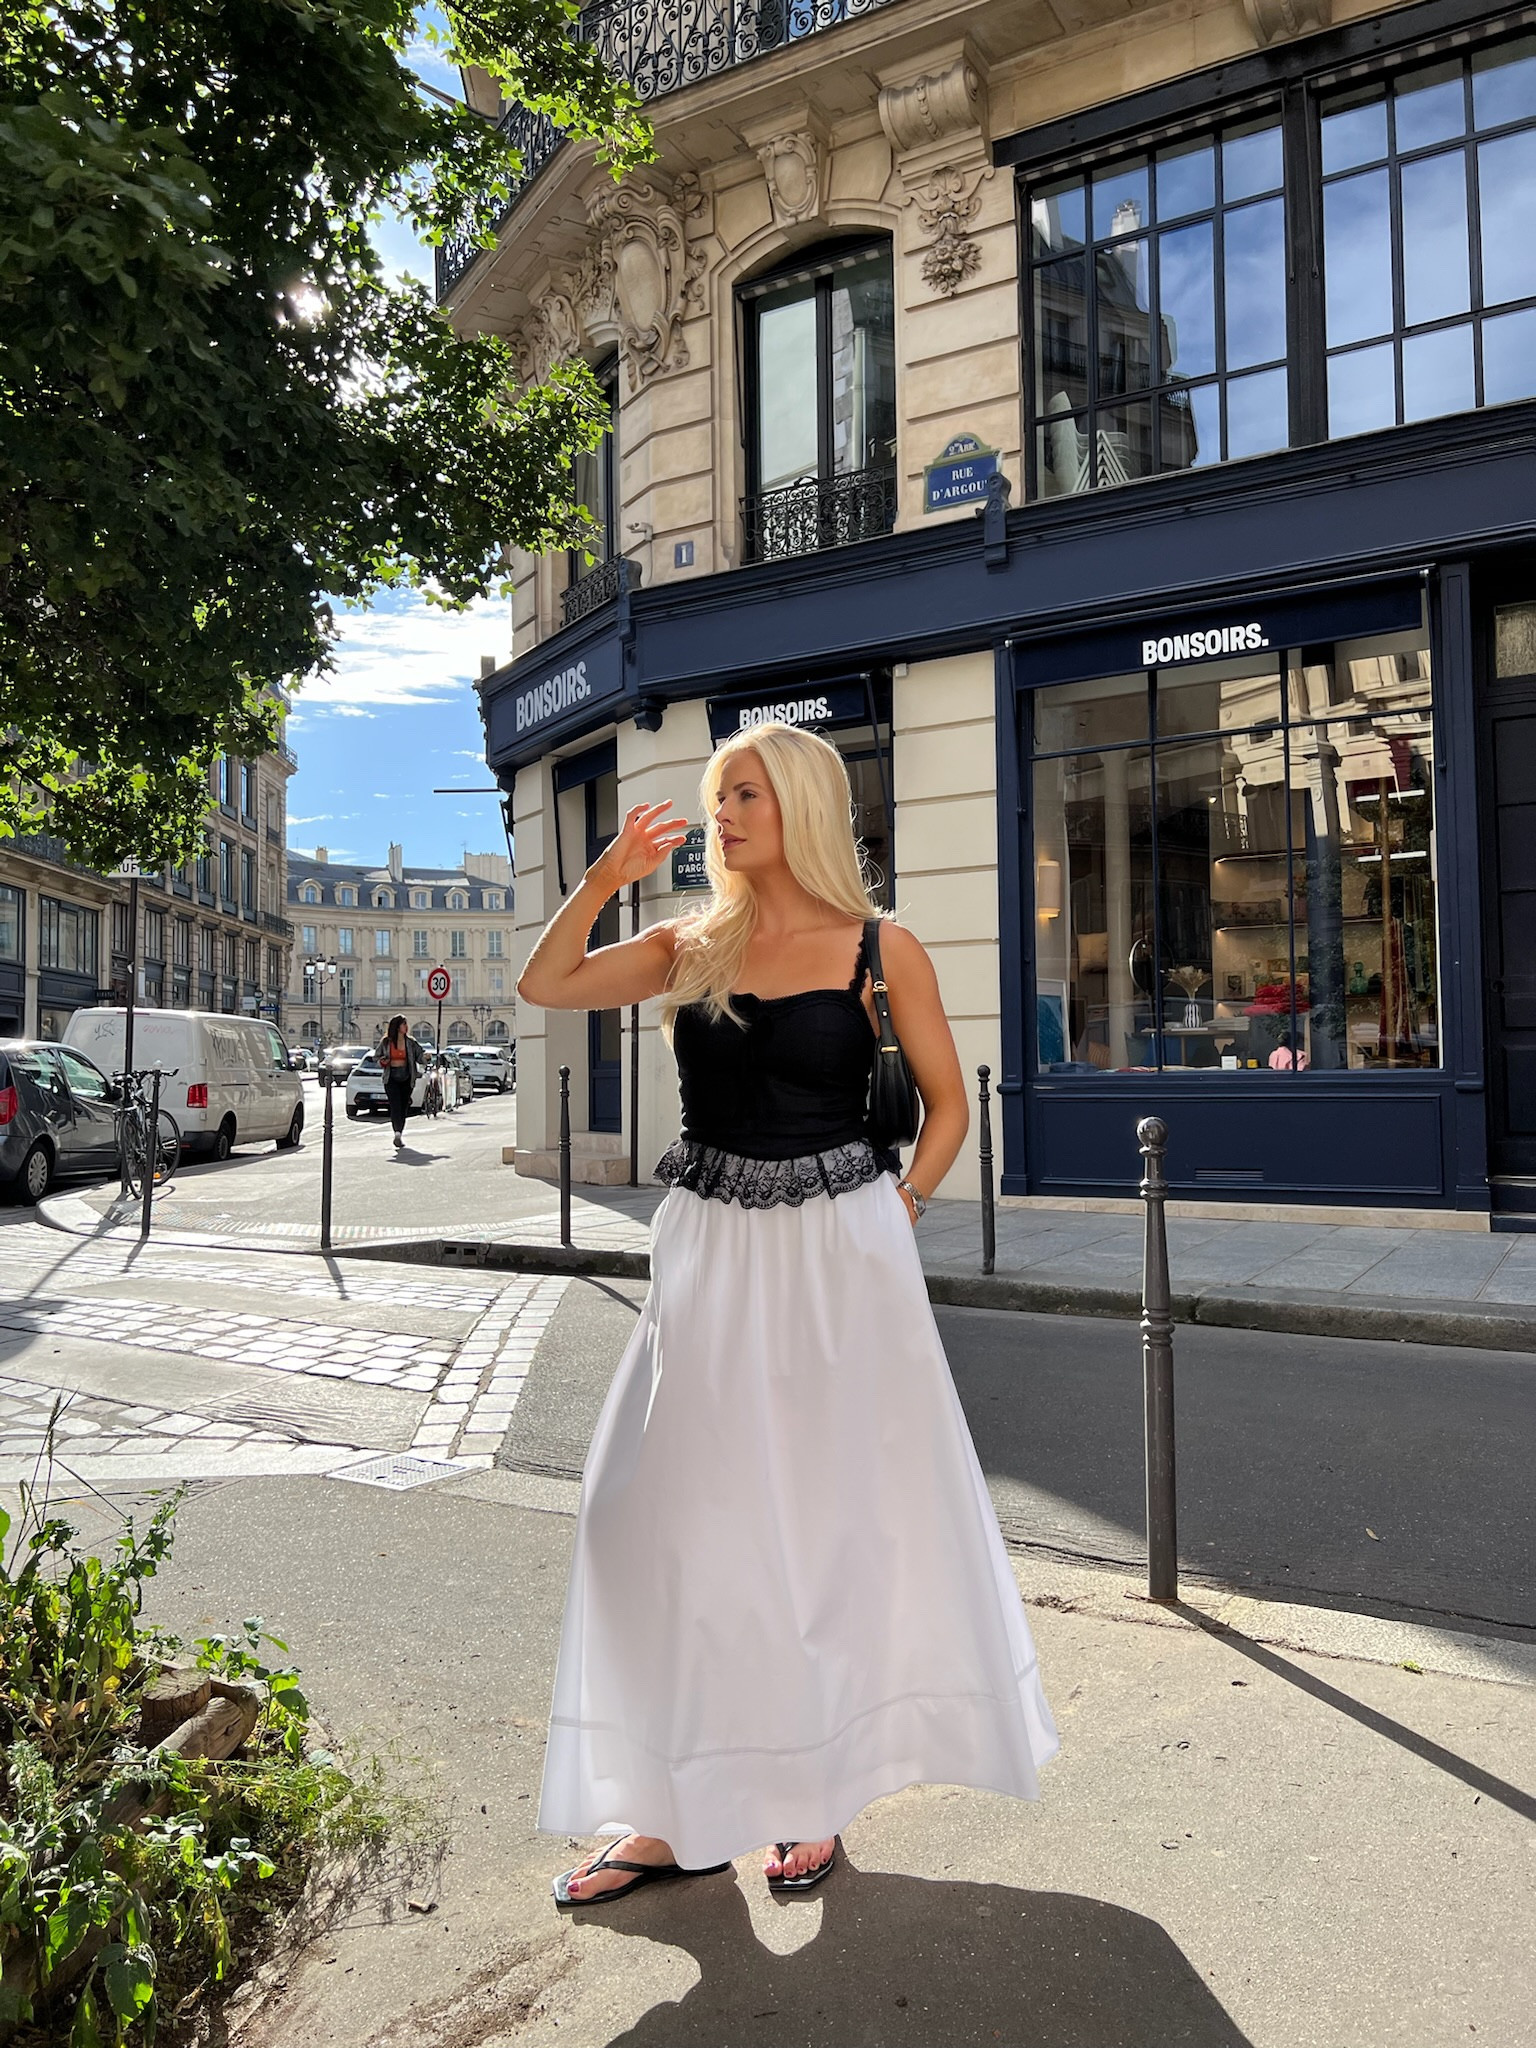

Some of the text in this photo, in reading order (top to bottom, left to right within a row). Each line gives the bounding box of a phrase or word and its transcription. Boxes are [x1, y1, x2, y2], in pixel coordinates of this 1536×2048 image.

[951, 466, 974, 481] RUE
[932, 479, 988, 501] D'ARGOU
[681, 545, 687, 563] 1
[1142, 622, 1269, 665] BONSOIRS.
[516, 661, 592, 733] BONSOIRS.
[739, 697, 833, 729] BONSOIRS.
[677, 862, 707, 874] D'ARGO
[432, 976, 446, 991] 30
